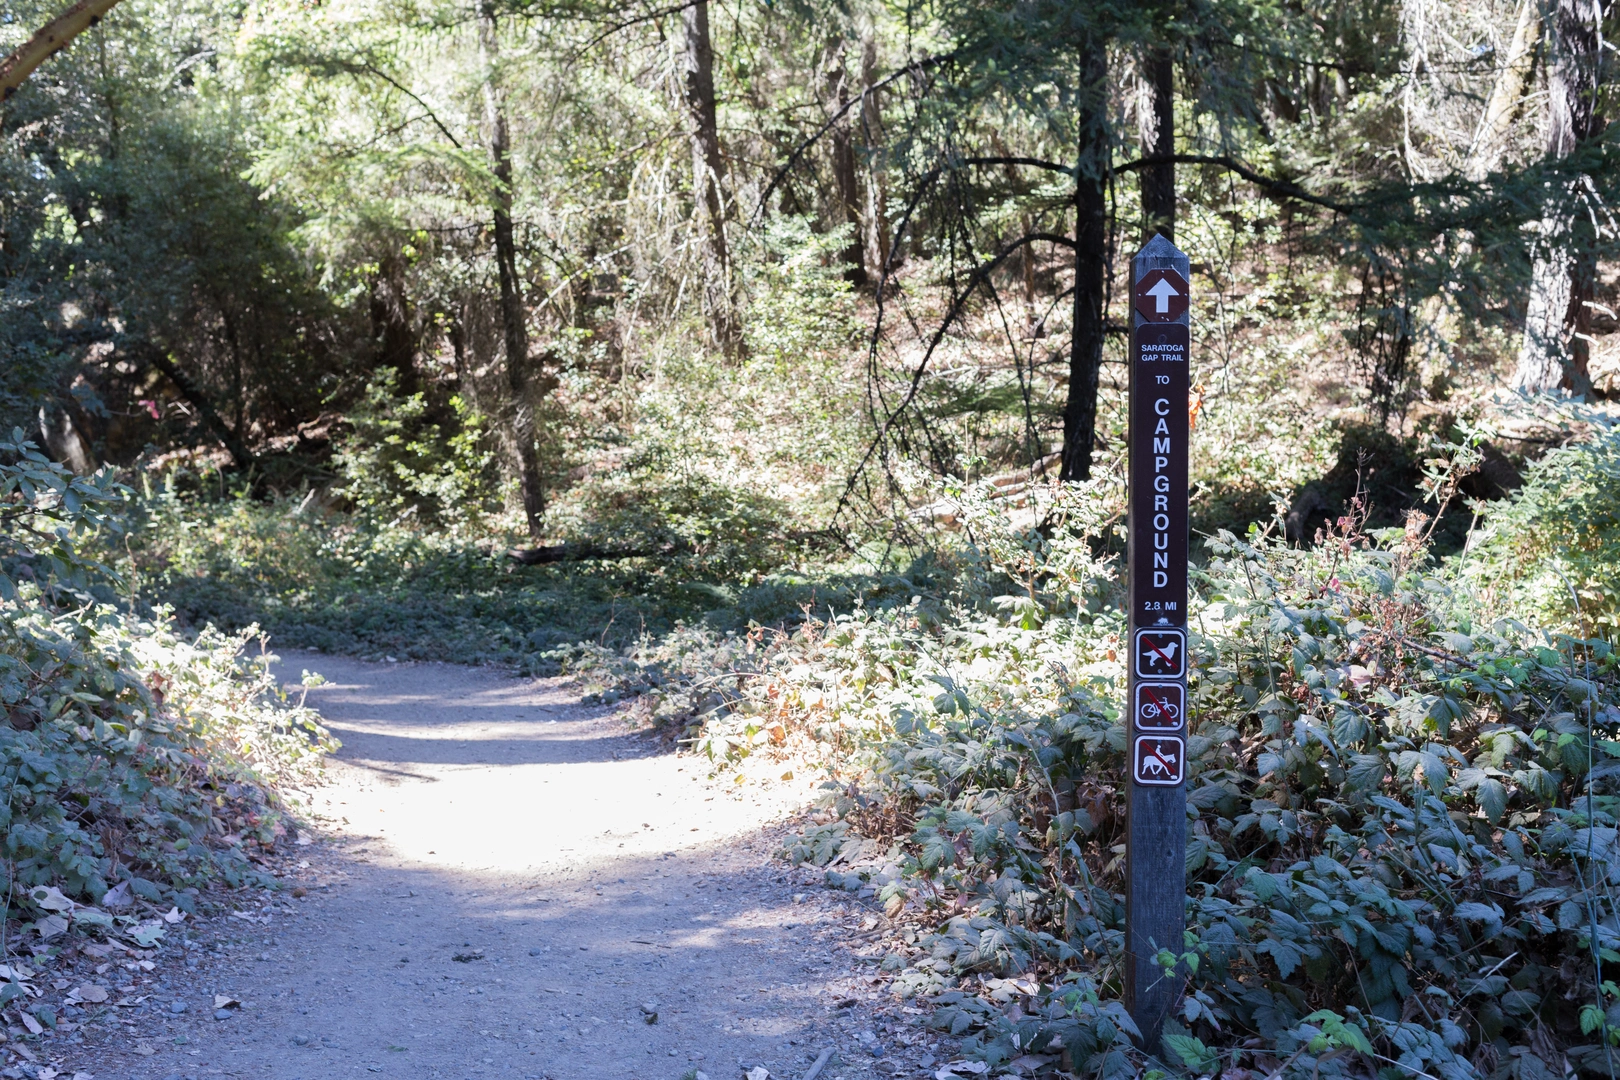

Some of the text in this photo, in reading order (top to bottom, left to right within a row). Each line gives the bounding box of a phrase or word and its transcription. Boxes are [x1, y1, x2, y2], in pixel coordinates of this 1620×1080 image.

[1141, 344, 1185, 352] SARATOGA
[1141, 354, 1184, 362] GAP TRAIL
[1155, 375, 1170, 385] TO
[1153, 398, 1171, 588] CAMPGROUND
[1144, 601, 1177, 611] 2.8 MI
